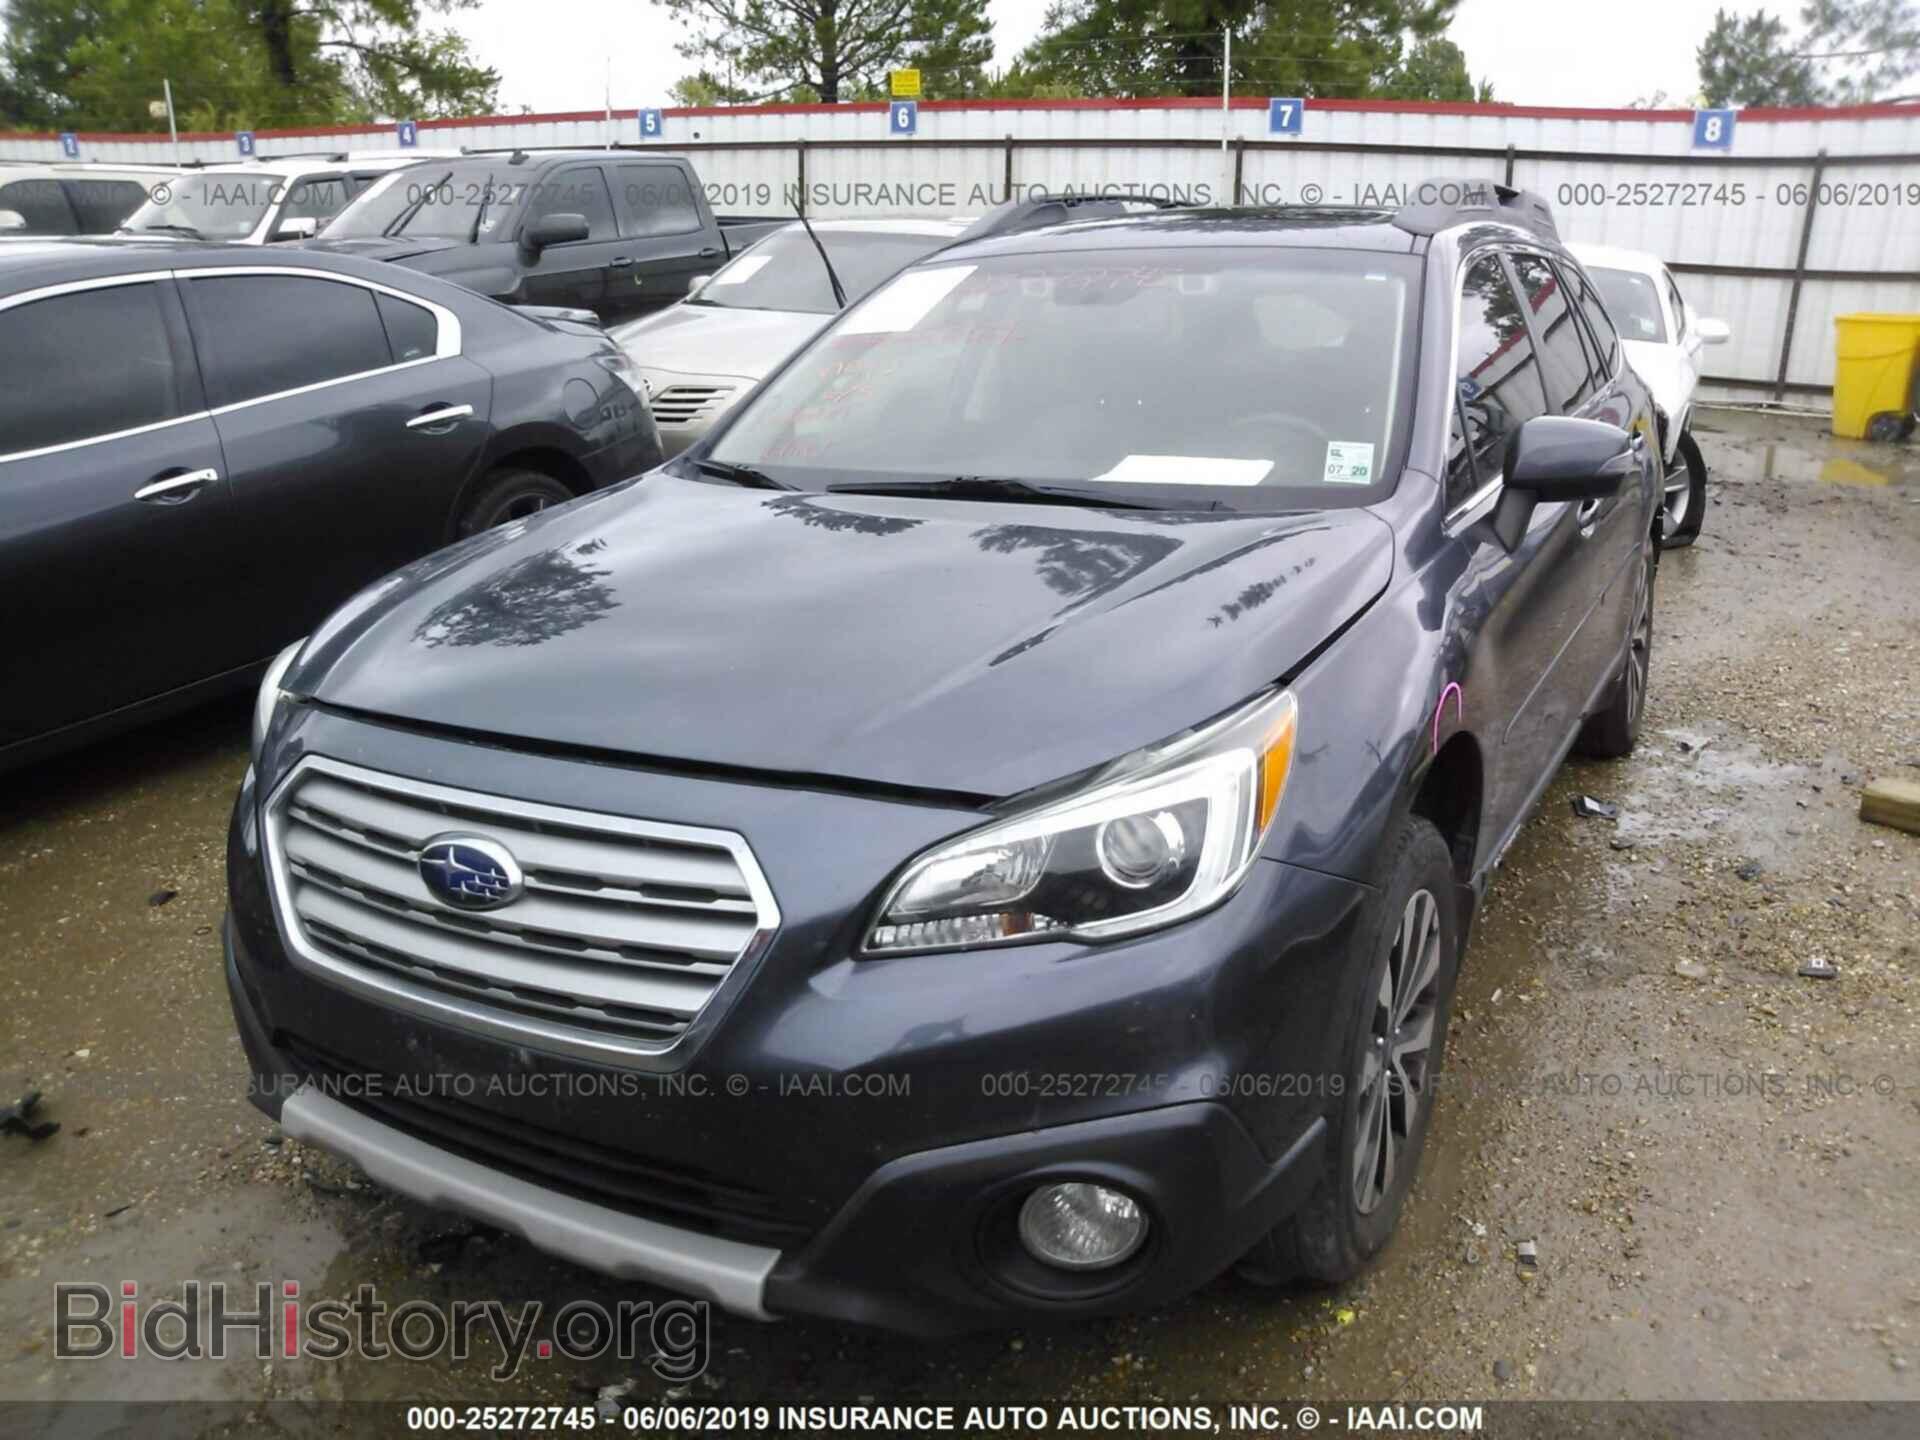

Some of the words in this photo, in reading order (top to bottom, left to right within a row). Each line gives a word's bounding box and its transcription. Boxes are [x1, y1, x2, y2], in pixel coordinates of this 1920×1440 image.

[644, 110, 657, 132] 5
[898, 107, 910, 128] 6
[1280, 102, 1295, 123] 7
[402, 120, 413, 143] 4
[1703, 116, 1726, 142] 8
[1352, 466, 1368, 476] 20
